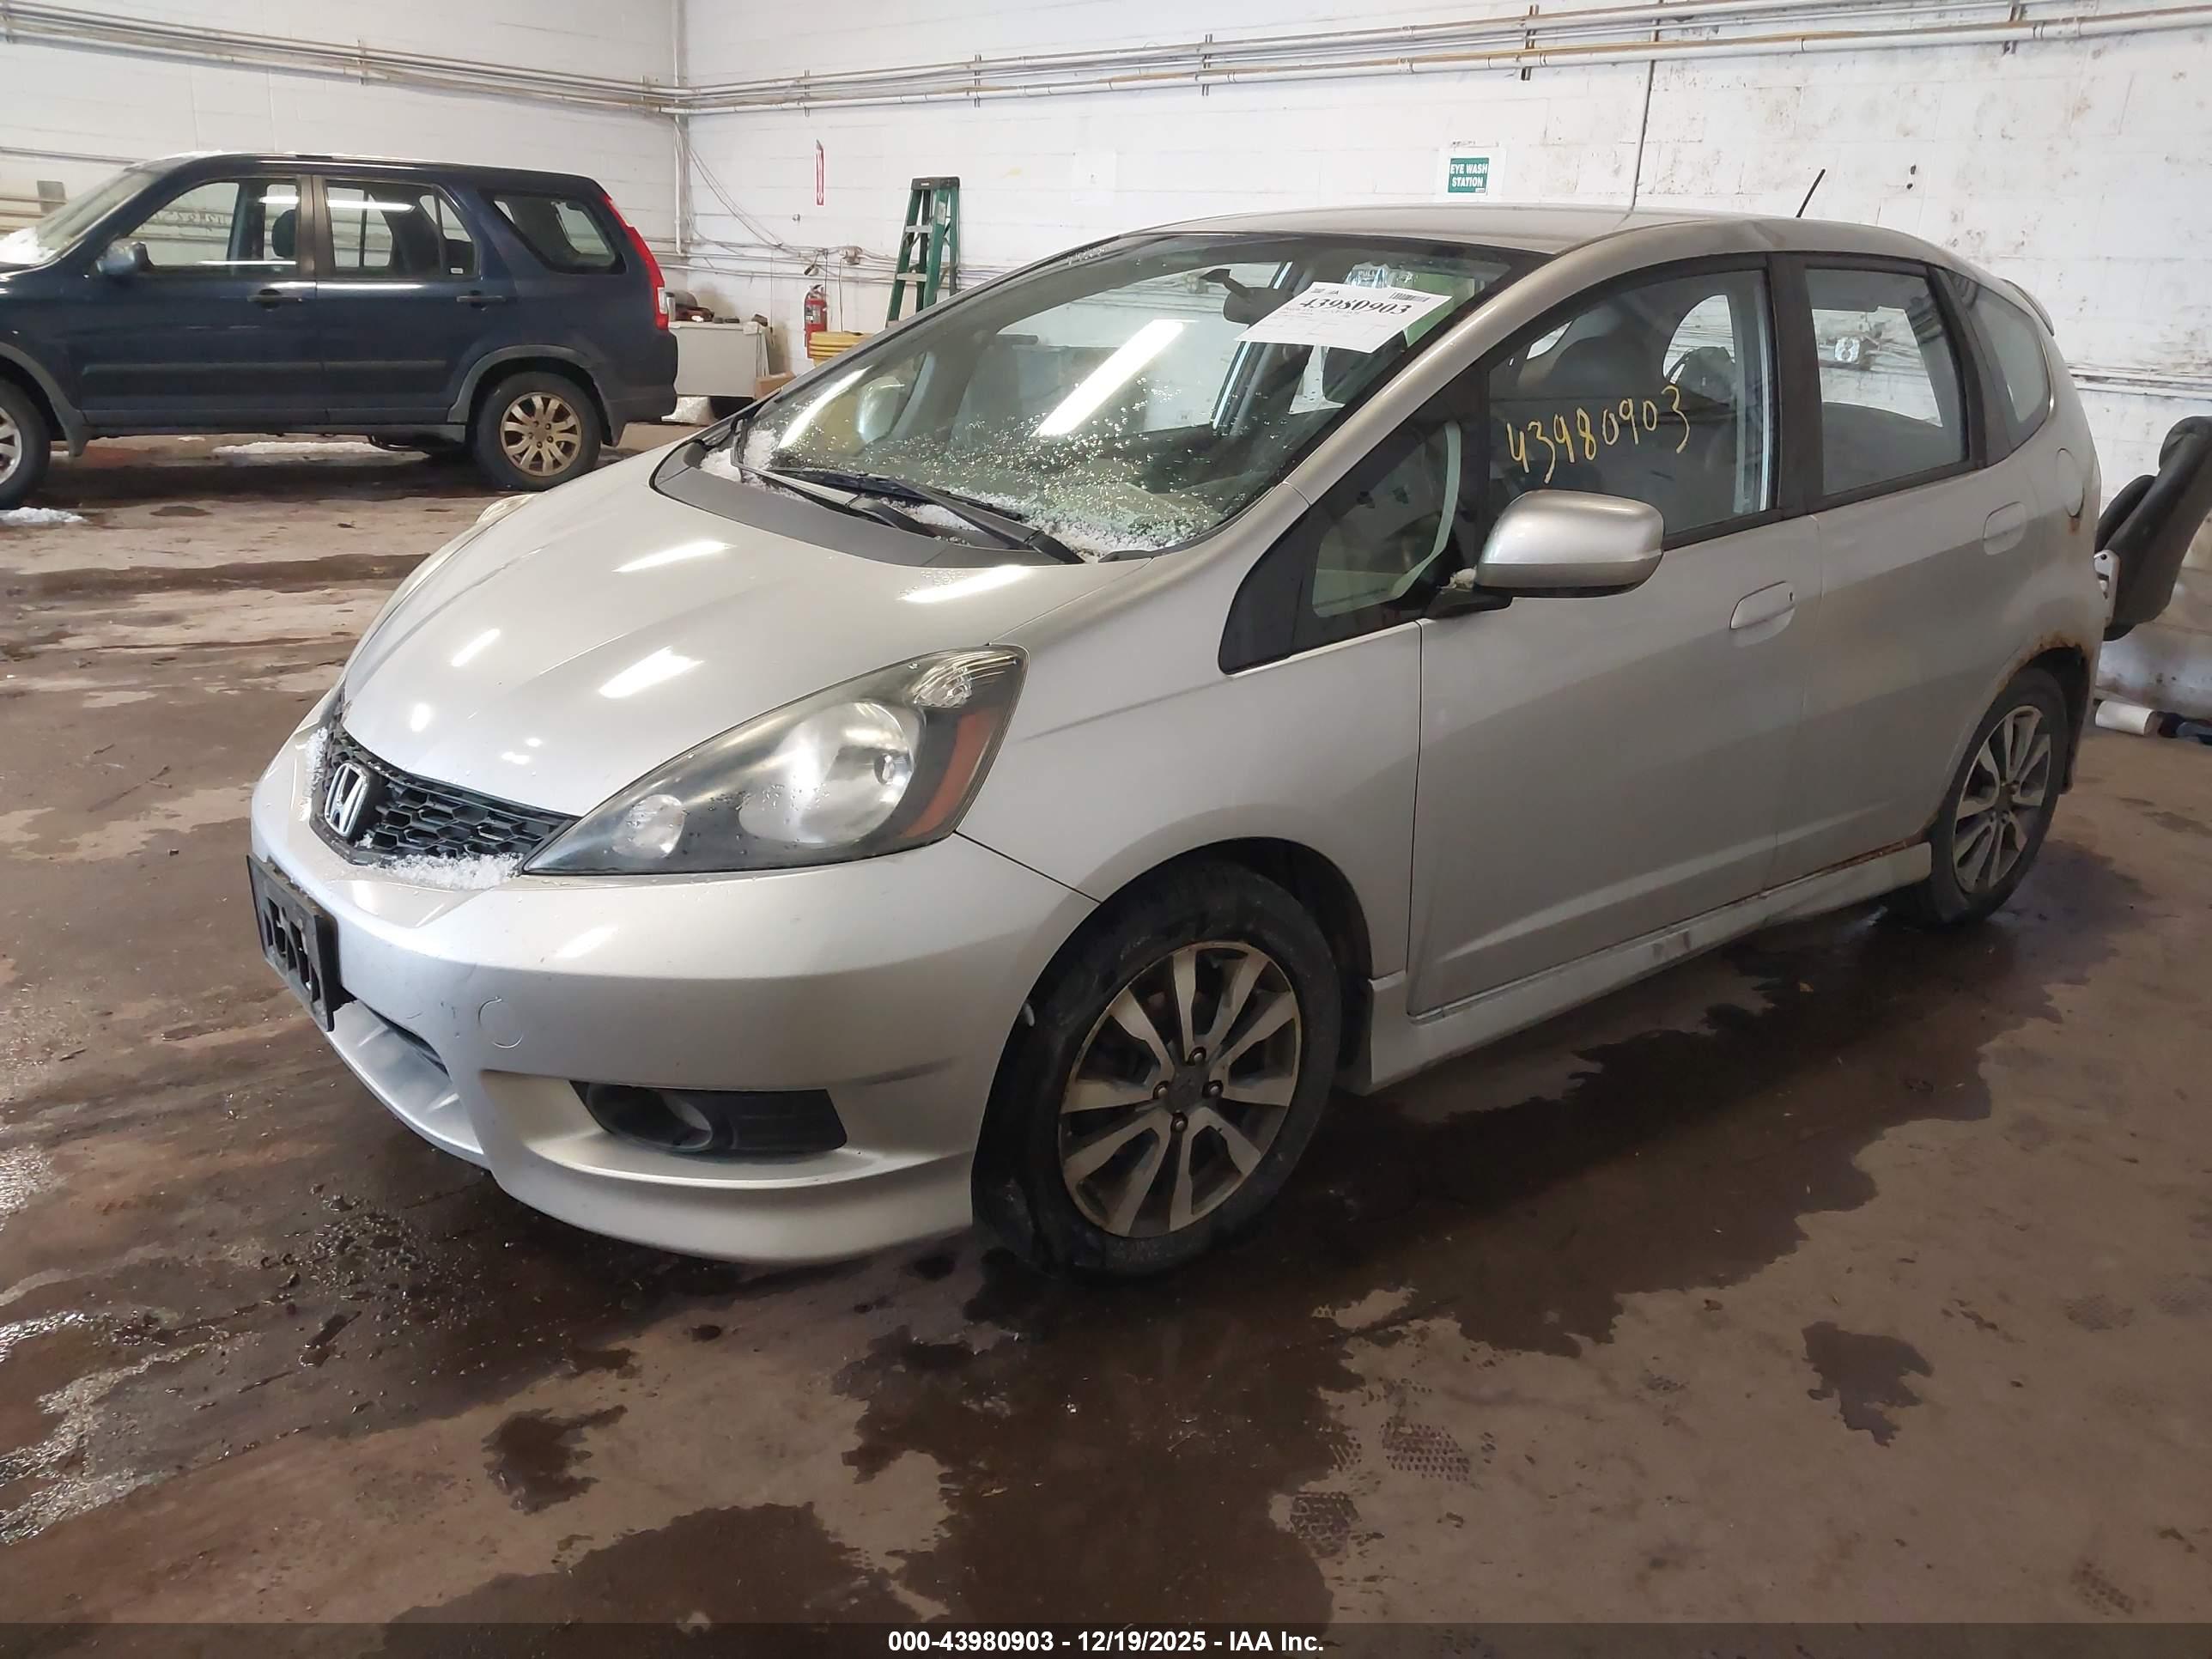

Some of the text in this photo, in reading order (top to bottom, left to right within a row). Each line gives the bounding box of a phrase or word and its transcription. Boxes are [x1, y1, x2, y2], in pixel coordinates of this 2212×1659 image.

[1450, 163, 1488, 174] EYE WASH
[1452, 176, 1484, 187] STATION
[1299, 297, 1413, 315] 43980903
[1507, 386, 1690, 484] 43980903
